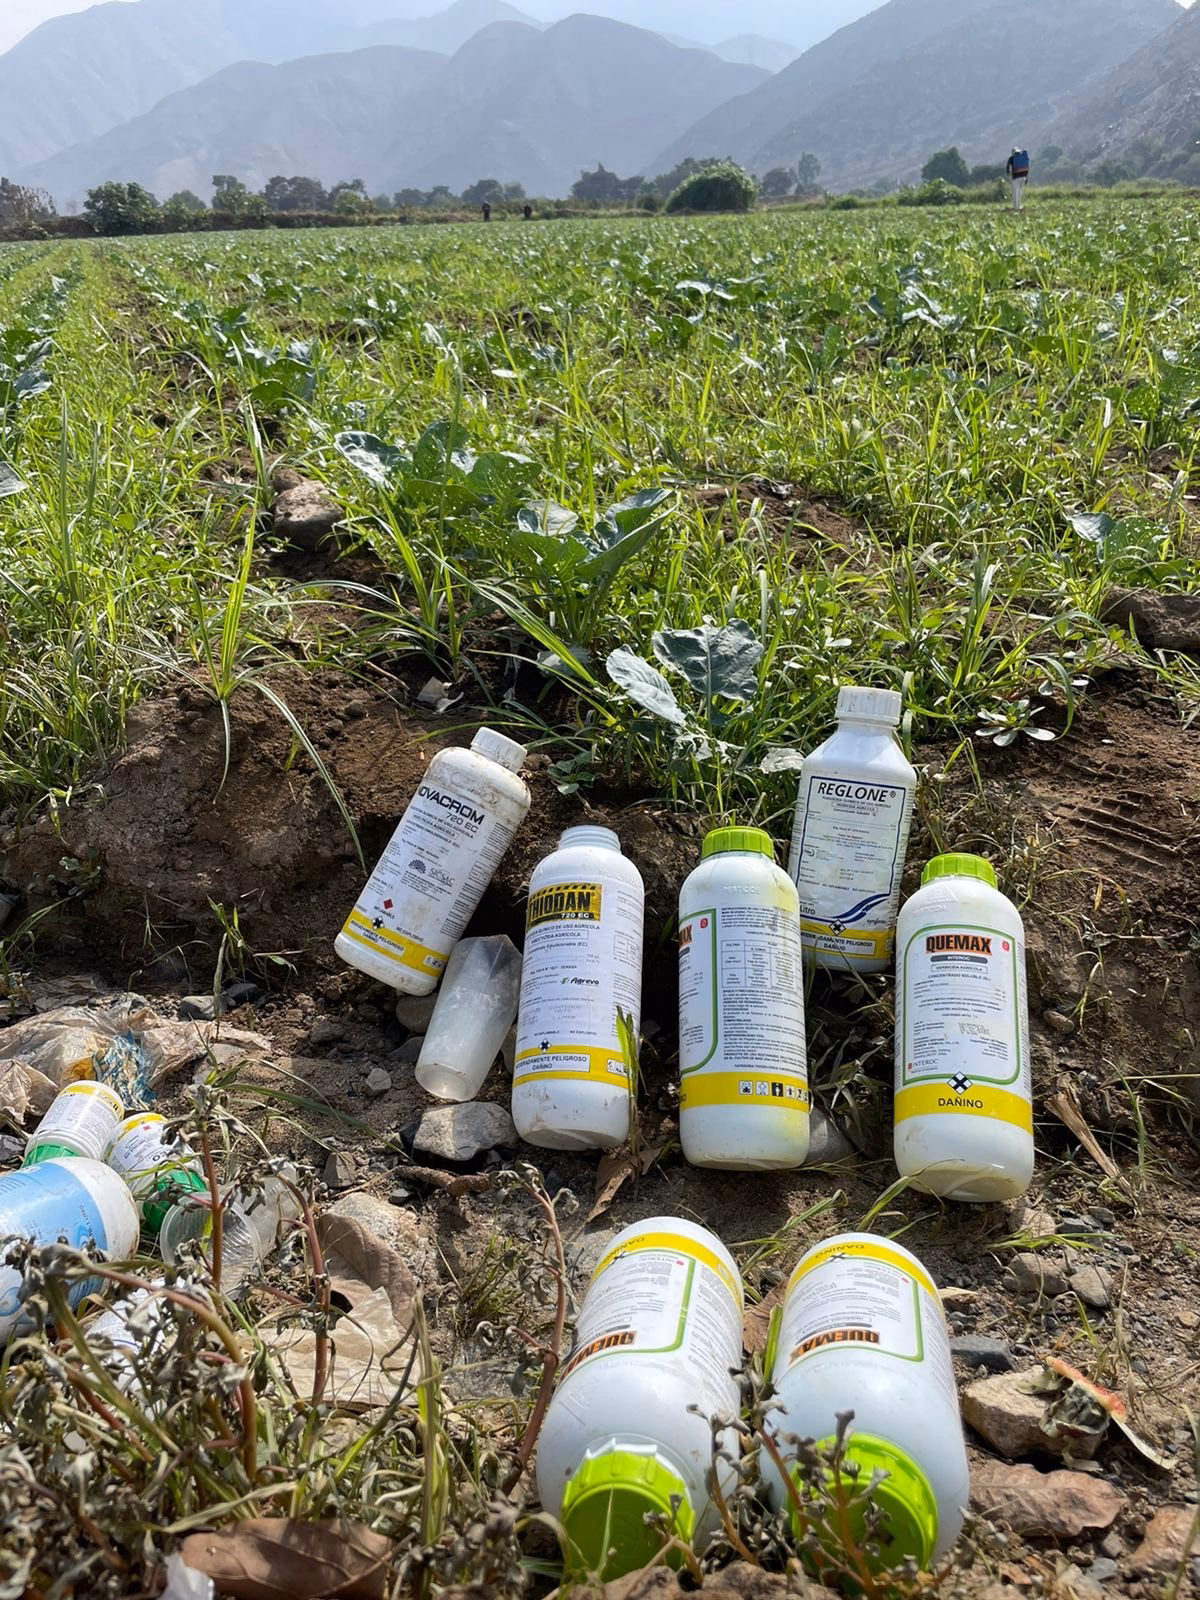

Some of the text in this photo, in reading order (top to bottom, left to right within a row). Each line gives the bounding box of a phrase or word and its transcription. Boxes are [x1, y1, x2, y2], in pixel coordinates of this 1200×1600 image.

[446, 812, 479, 833] 720 EC
[926, 935, 992, 954] QUEMAX
[570, 977, 600, 985] Agrevo
[938, 1097, 984, 1109] DAÑINO
